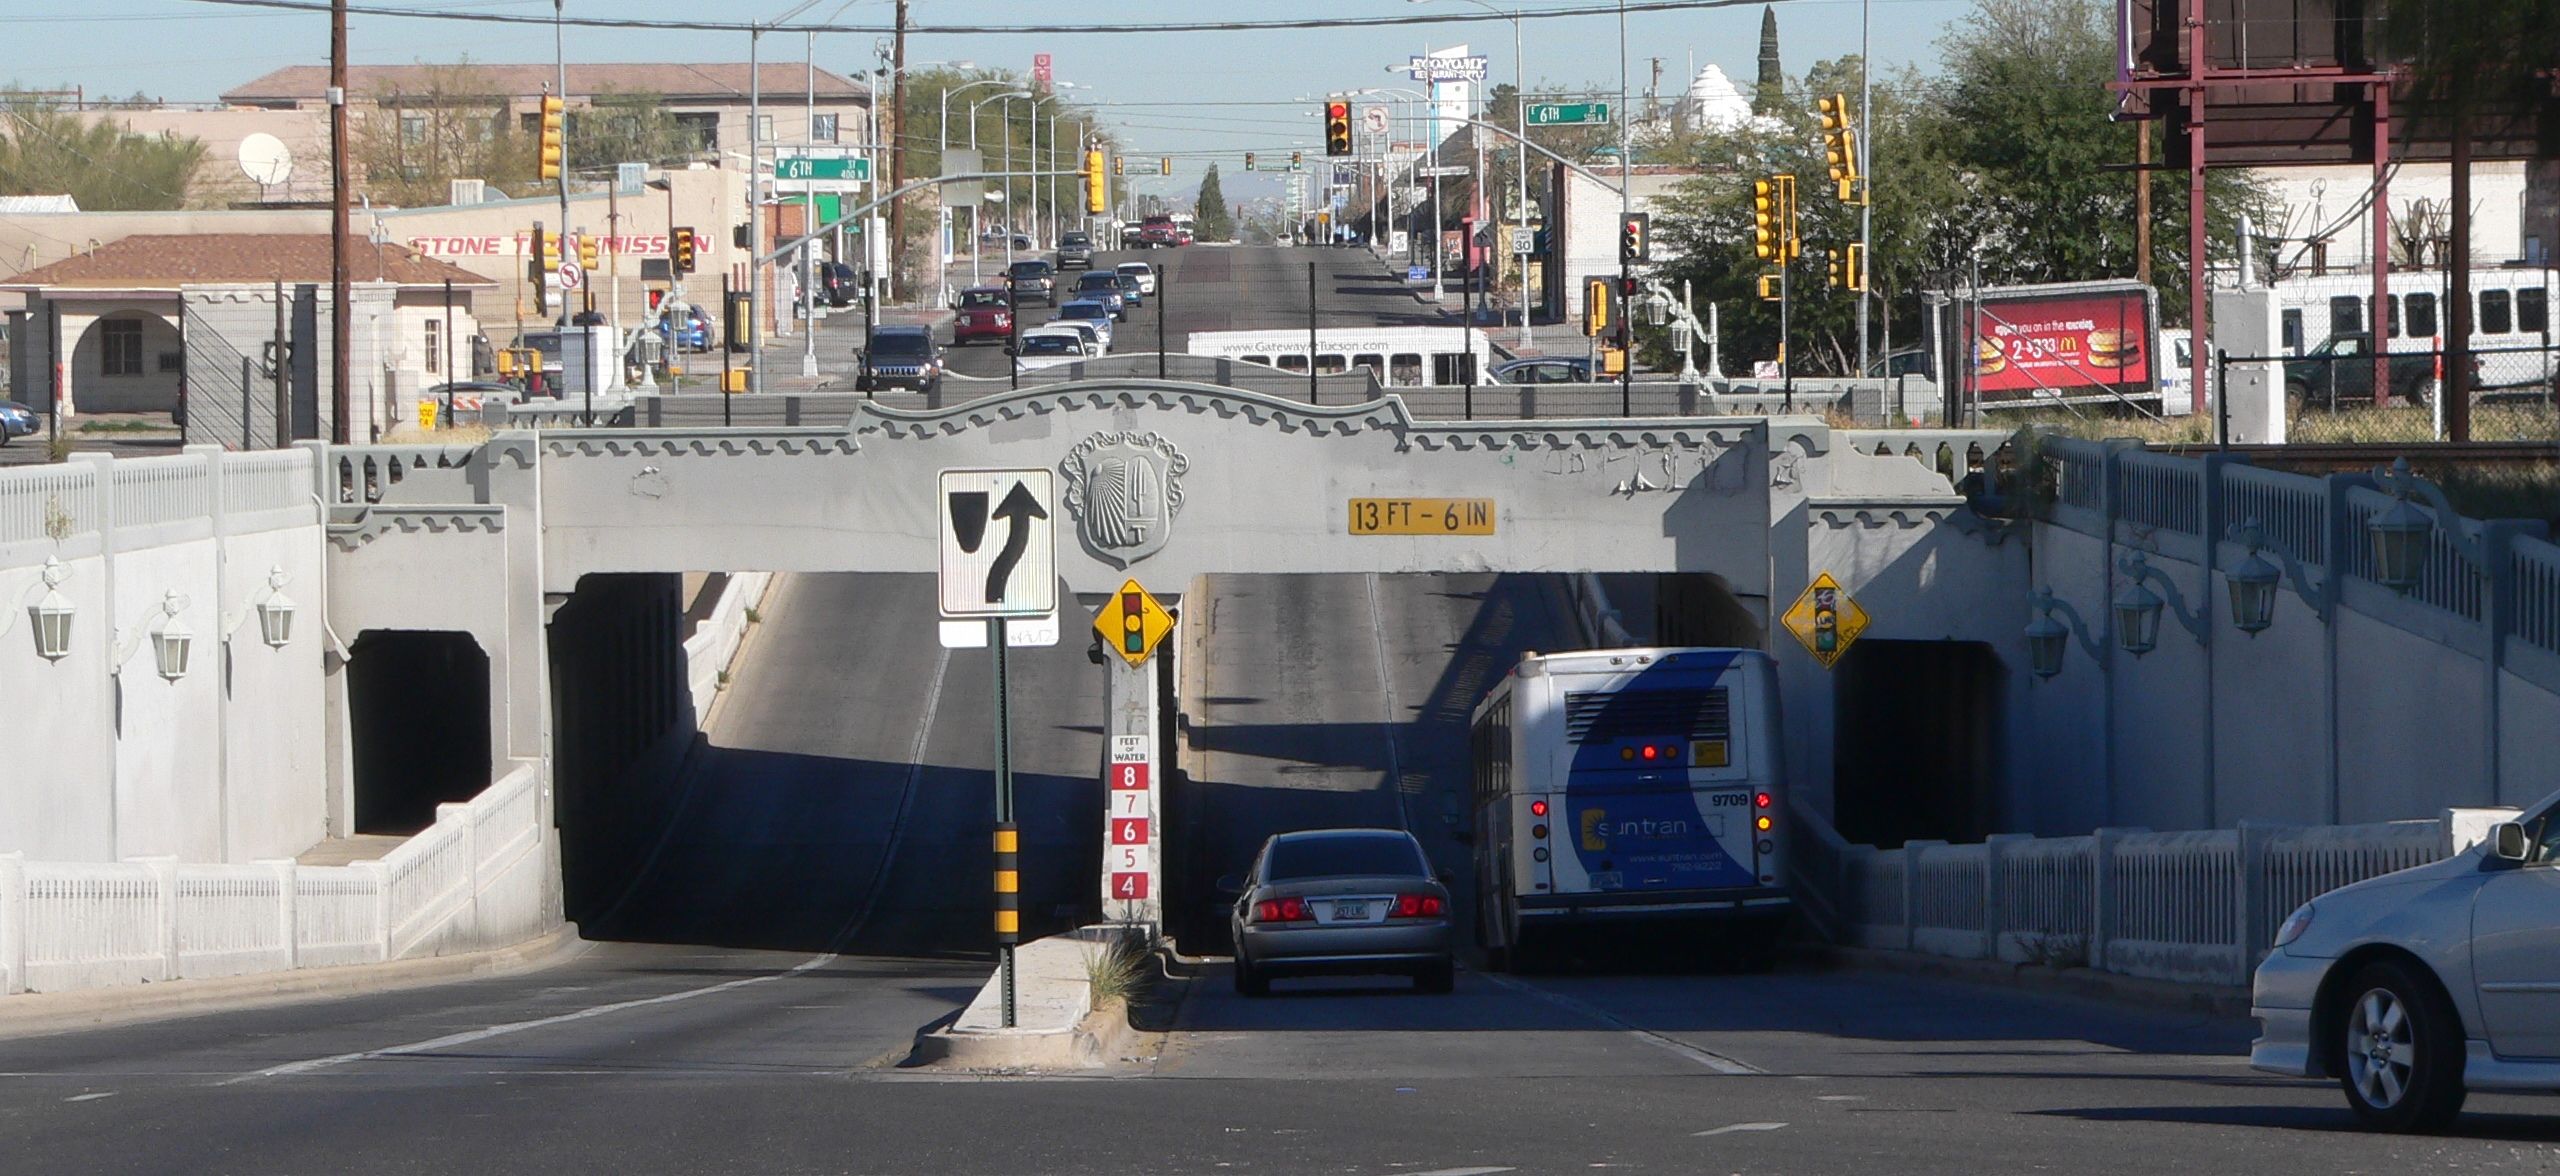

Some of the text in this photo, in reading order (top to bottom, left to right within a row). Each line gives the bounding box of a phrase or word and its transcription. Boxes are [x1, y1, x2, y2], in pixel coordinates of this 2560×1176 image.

[1412, 58, 1487, 70] ECONOMY
[1531, 106, 1560, 122] E 6TH
[779, 160, 812, 178] W 6TH
[848, 160, 856, 169] ST
[841, 169, 855, 179] 400
[1515, 240, 1531, 250] 30
[2019, 323, 2032, 334] you
[2033, 323, 2042, 332] on
[2052, 320, 2064, 331] the
[1356, 502, 1379, 530] 13
[1388, 502, 1411, 526] FT
[1444, 503, 1459, 530] 6
[1467, 502, 1486, 526] IN
[1120, 737, 1139, 746] FEET
[1114, 753, 1146, 761] WATER
[1124, 766, 1136, 787] 8
[1125, 794, 1136, 813] 7
[1712, 793, 1748, 806] 9709
[1124, 821, 1136, 841] 6
[1125, 849, 1135, 868] 5
[1122, 876, 1135, 896] 4
